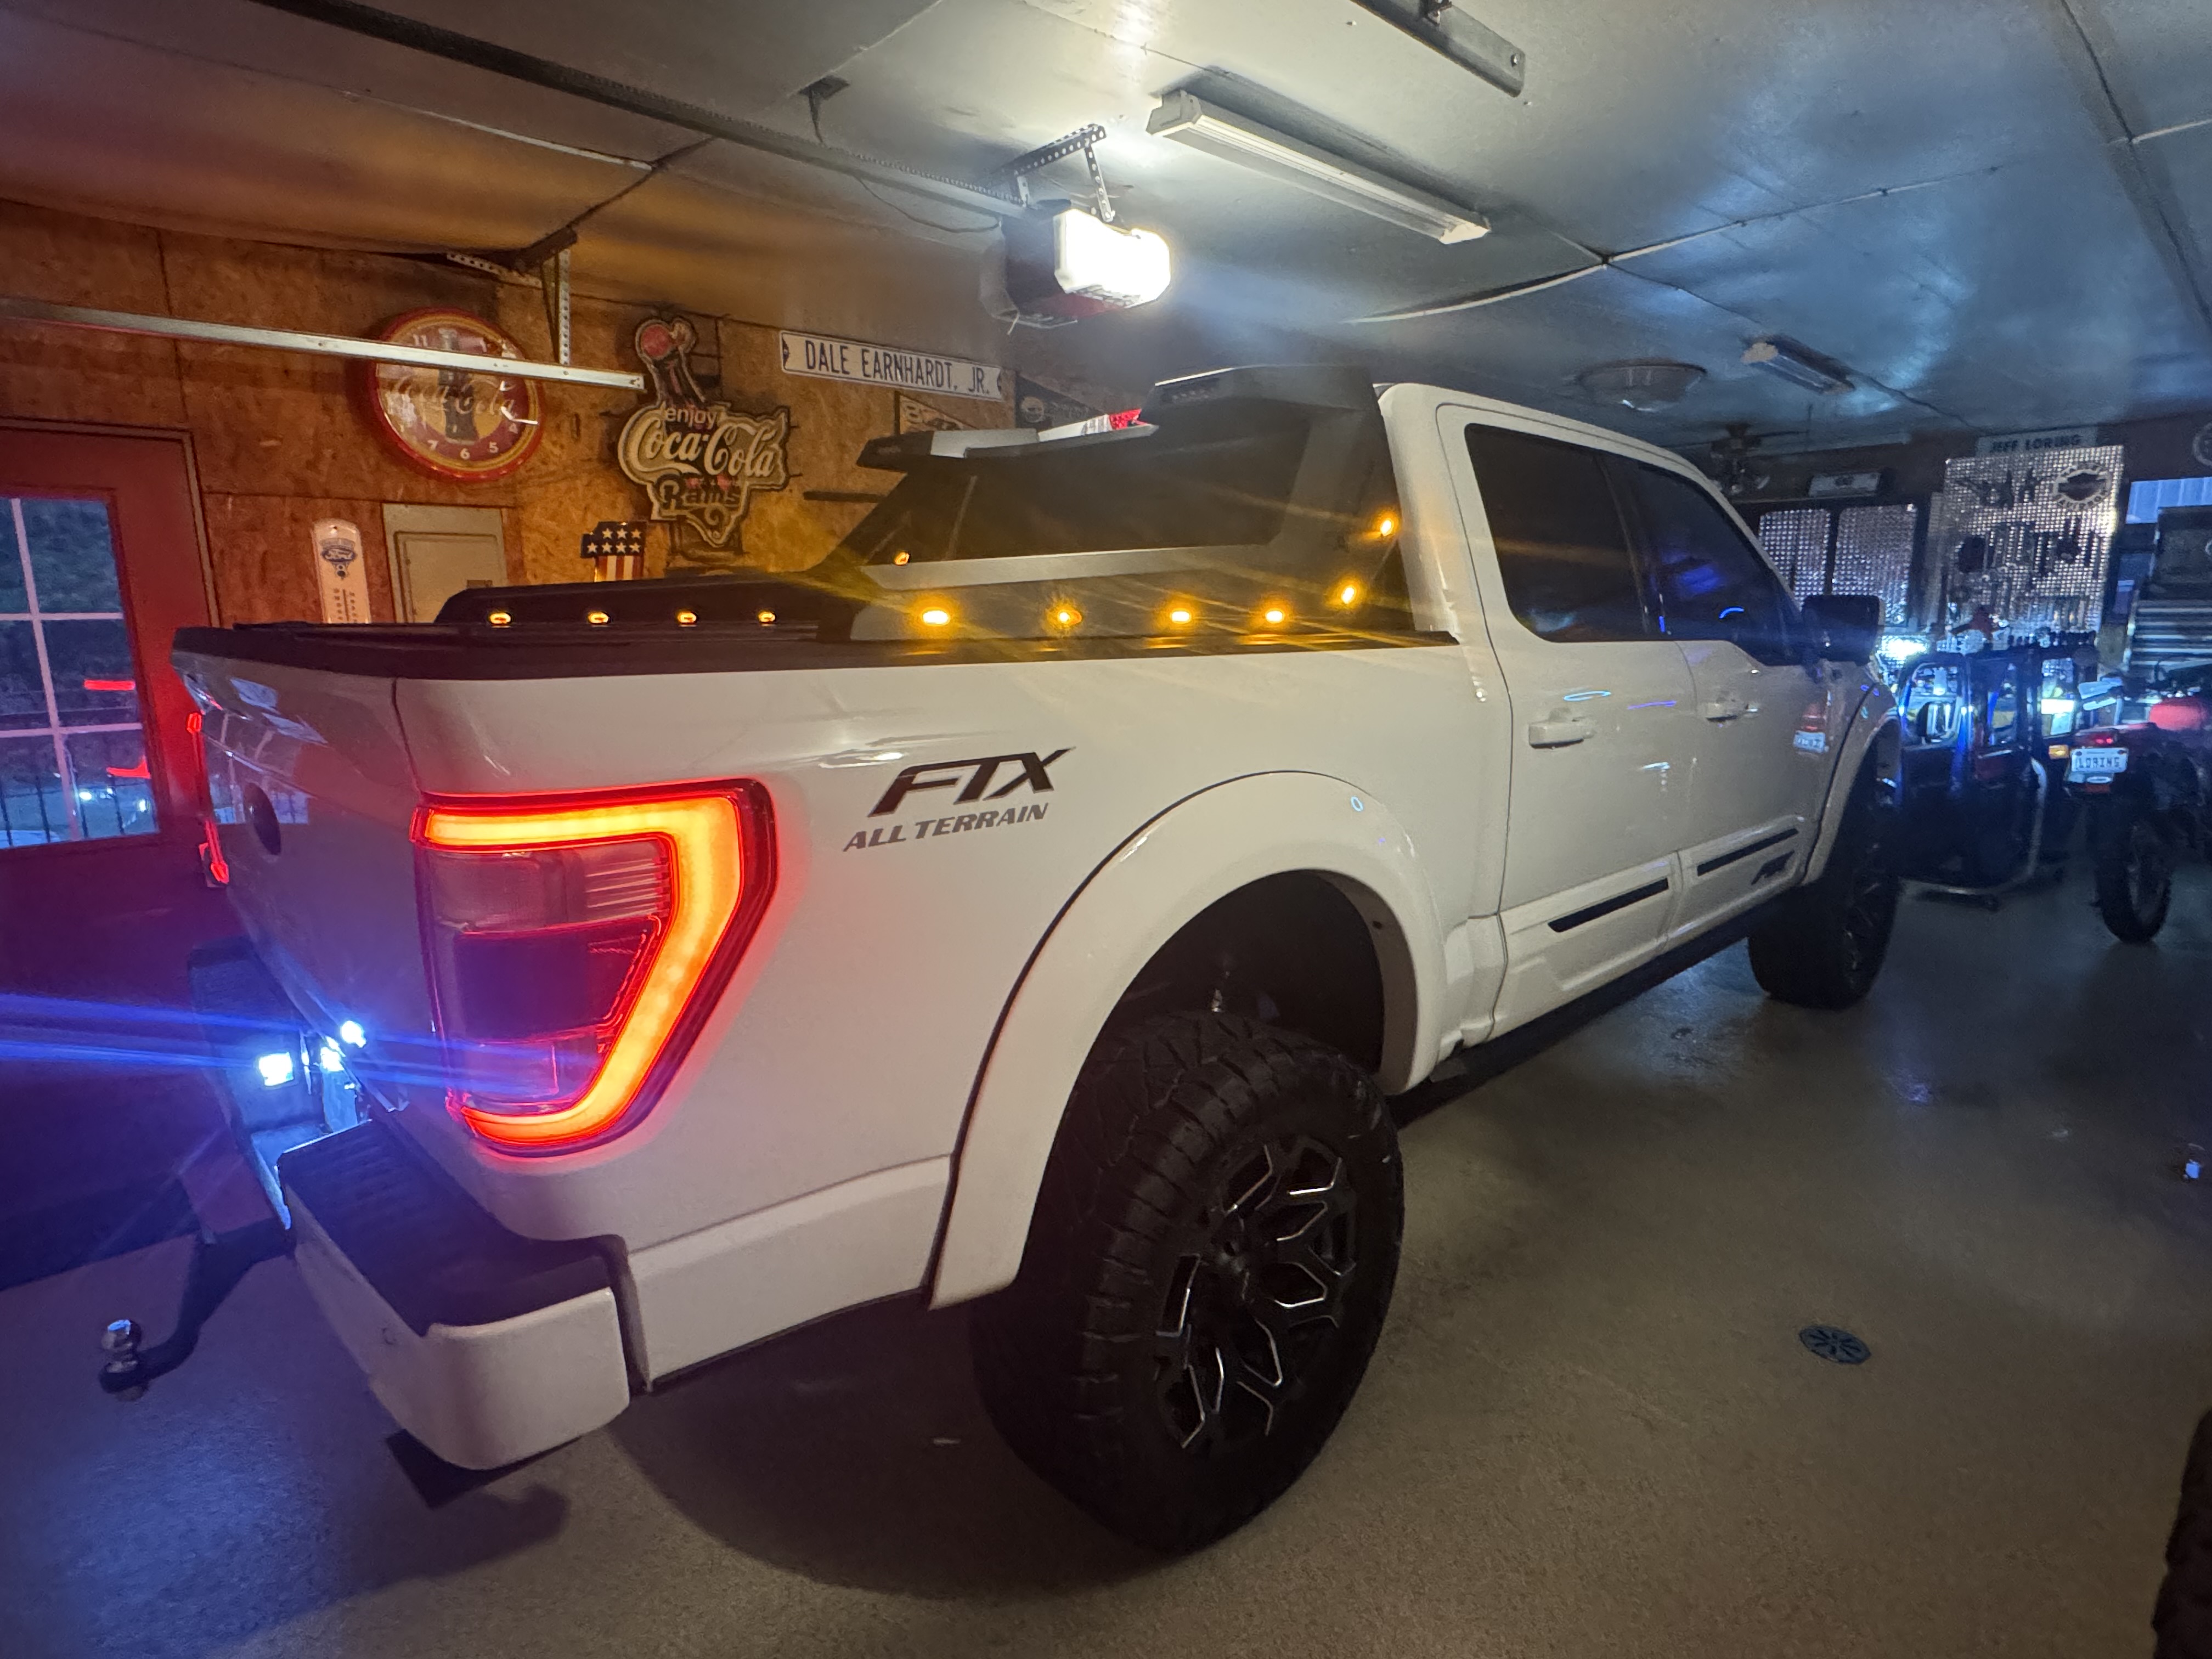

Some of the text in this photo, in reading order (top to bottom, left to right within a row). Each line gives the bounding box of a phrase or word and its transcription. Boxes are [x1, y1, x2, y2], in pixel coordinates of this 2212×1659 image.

[805, 340, 850, 375] DALE
[665, 405, 718, 428] enjoy
[427, 440, 438, 451] 7
[460, 448, 471, 460] 6
[489, 442, 499, 454] 5
[629, 415, 777, 477] Coca-Cola
[868, 747, 1076, 817] FTX
[843, 802, 1049, 852] ALL TERRAIN
